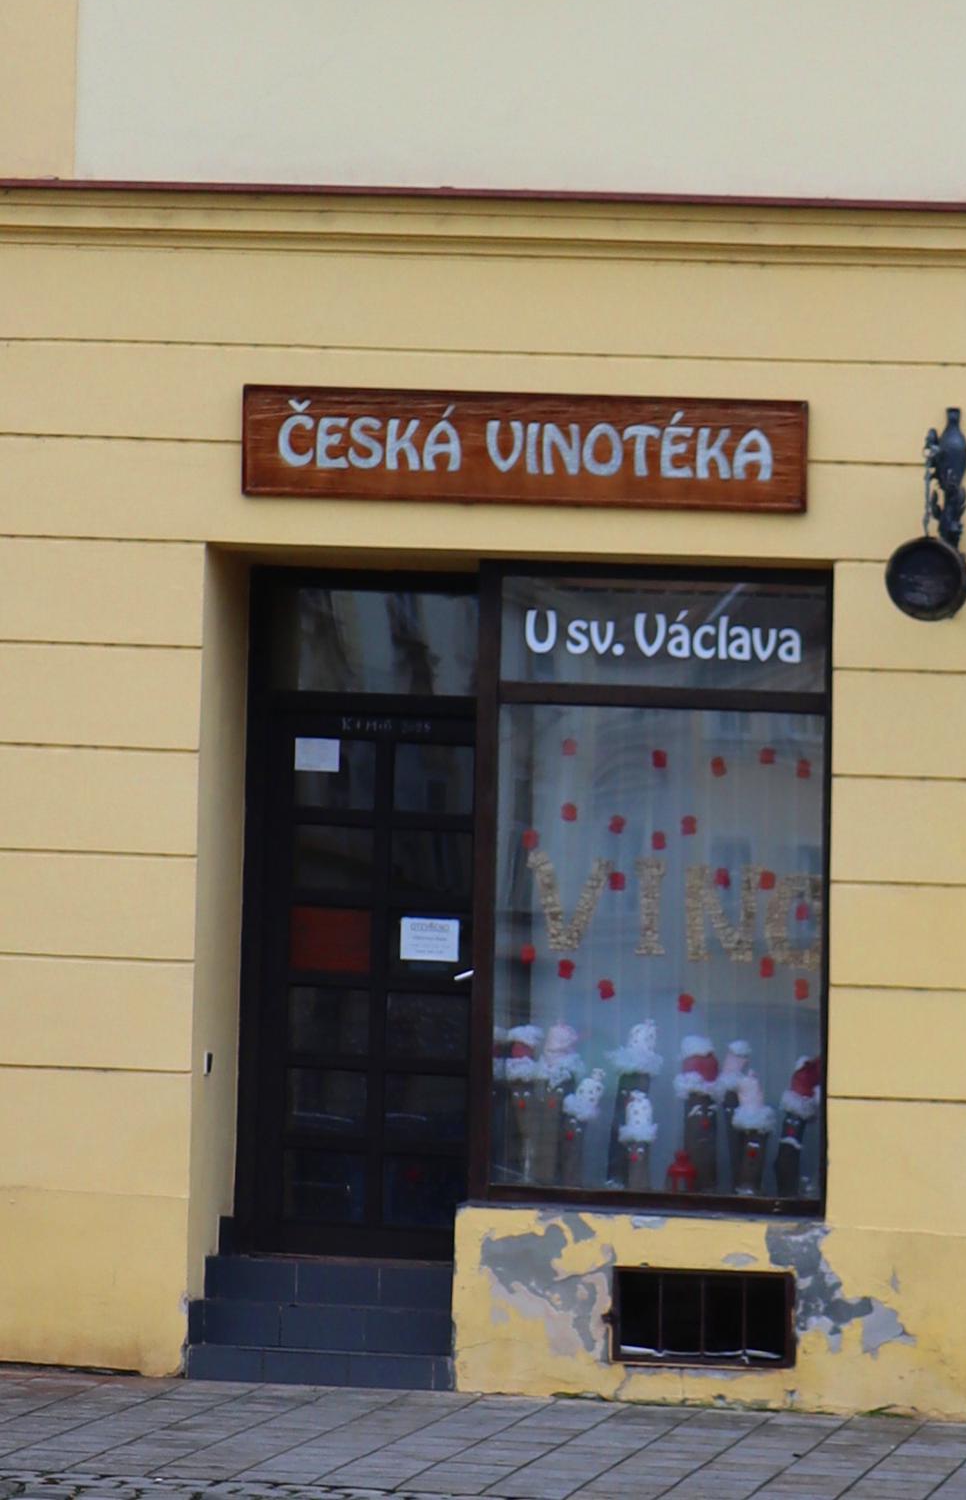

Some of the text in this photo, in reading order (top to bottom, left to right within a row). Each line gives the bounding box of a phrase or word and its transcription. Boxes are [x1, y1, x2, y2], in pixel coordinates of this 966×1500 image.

[277, 399, 774, 482] ČESKÁ VINOTÉKA
[524, 608, 802, 664] U sv. Václava
[527, 850, 822, 970] VINO
